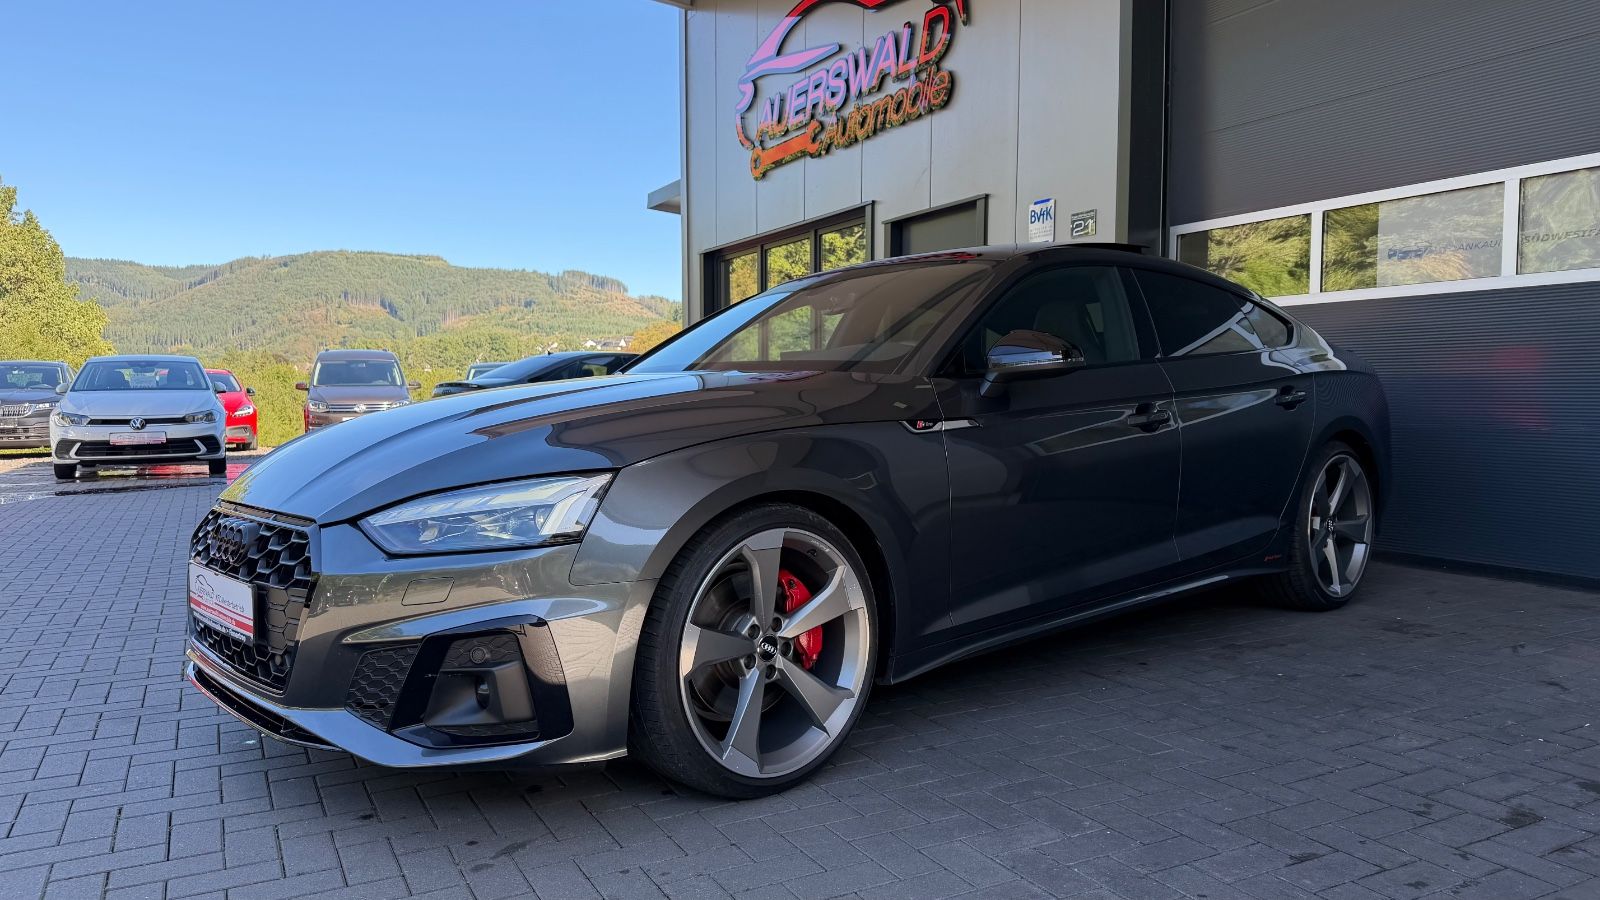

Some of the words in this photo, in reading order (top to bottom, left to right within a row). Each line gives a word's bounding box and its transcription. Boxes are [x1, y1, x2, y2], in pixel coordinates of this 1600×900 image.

[756, 5, 951, 140] AUERSWALD
[821, 64, 952, 154] Automobile
[1072, 218, 1094, 236] 21
